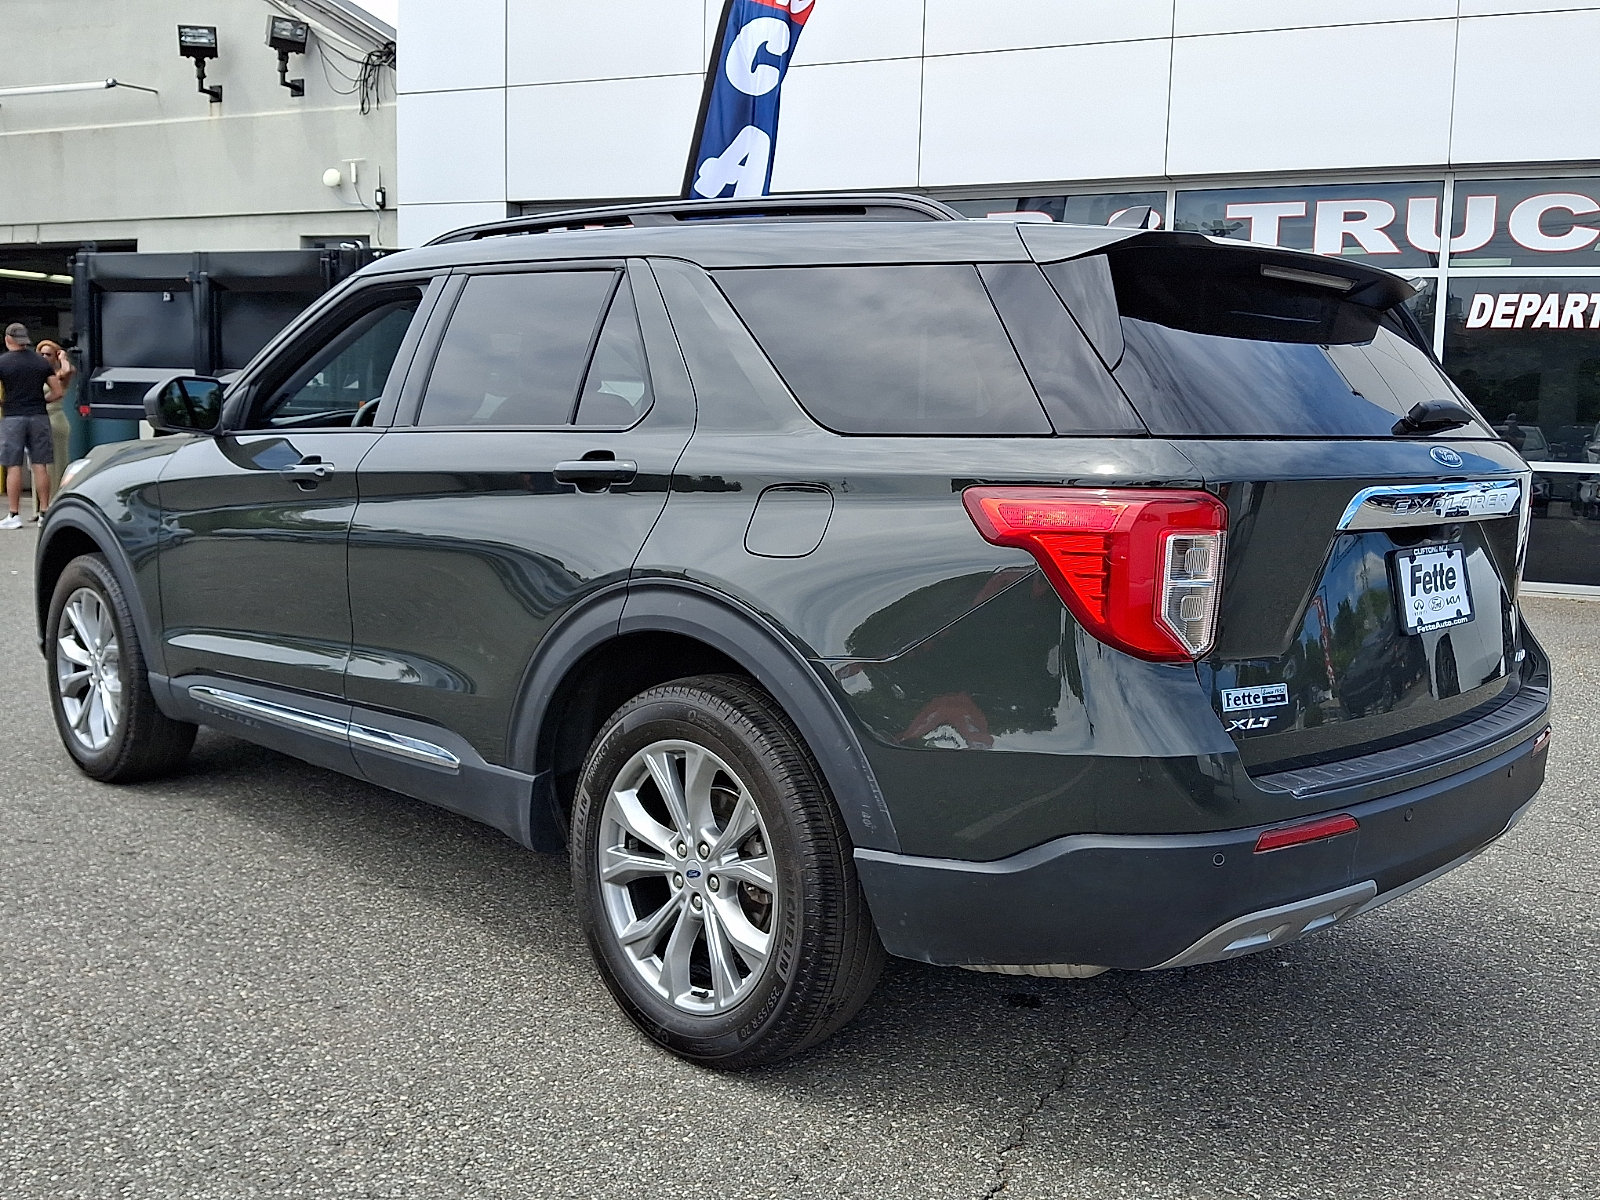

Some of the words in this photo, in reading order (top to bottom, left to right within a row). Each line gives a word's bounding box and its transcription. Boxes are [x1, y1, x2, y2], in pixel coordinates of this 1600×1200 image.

[1391, 493, 1509, 516] EXPLORER
[1410, 562, 1457, 597] Fette
[1416, 617, 1468, 633] FetteAuto.com
[1225, 691, 1261, 708] Fette
[1225, 715, 1278, 732] XLT
[587, 742, 610, 782] PRIMACY
